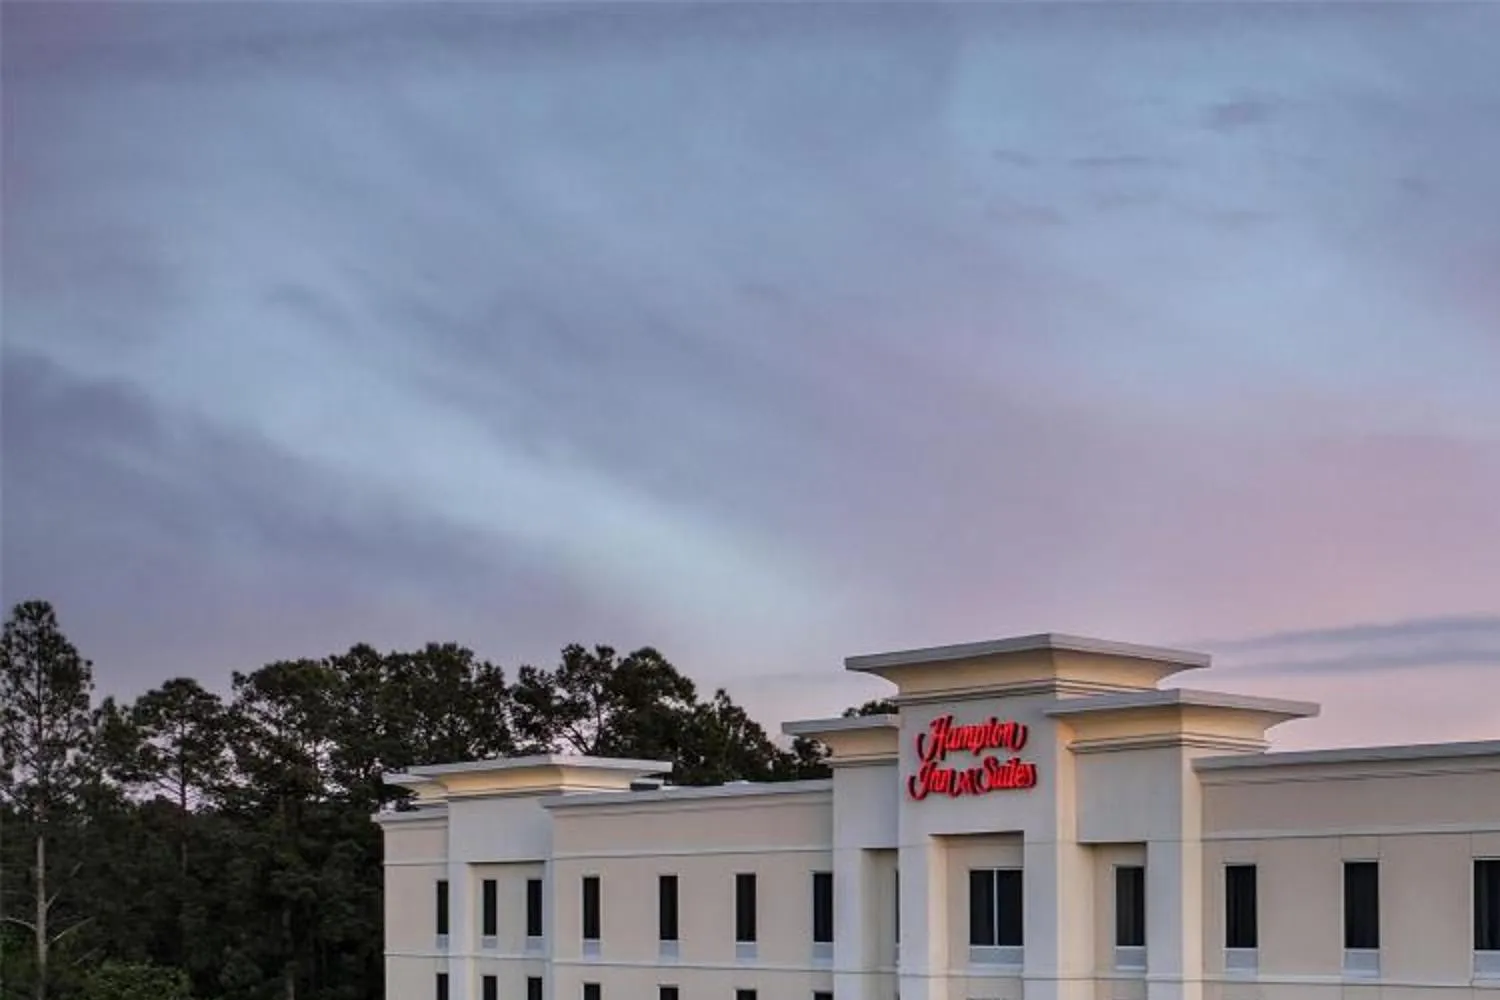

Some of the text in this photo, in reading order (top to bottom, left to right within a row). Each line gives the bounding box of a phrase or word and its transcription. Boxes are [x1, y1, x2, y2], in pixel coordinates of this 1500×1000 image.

[916, 715, 1028, 761] Hampton
[908, 762, 959, 800] Inn
[976, 756, 1037, 793] Suites
